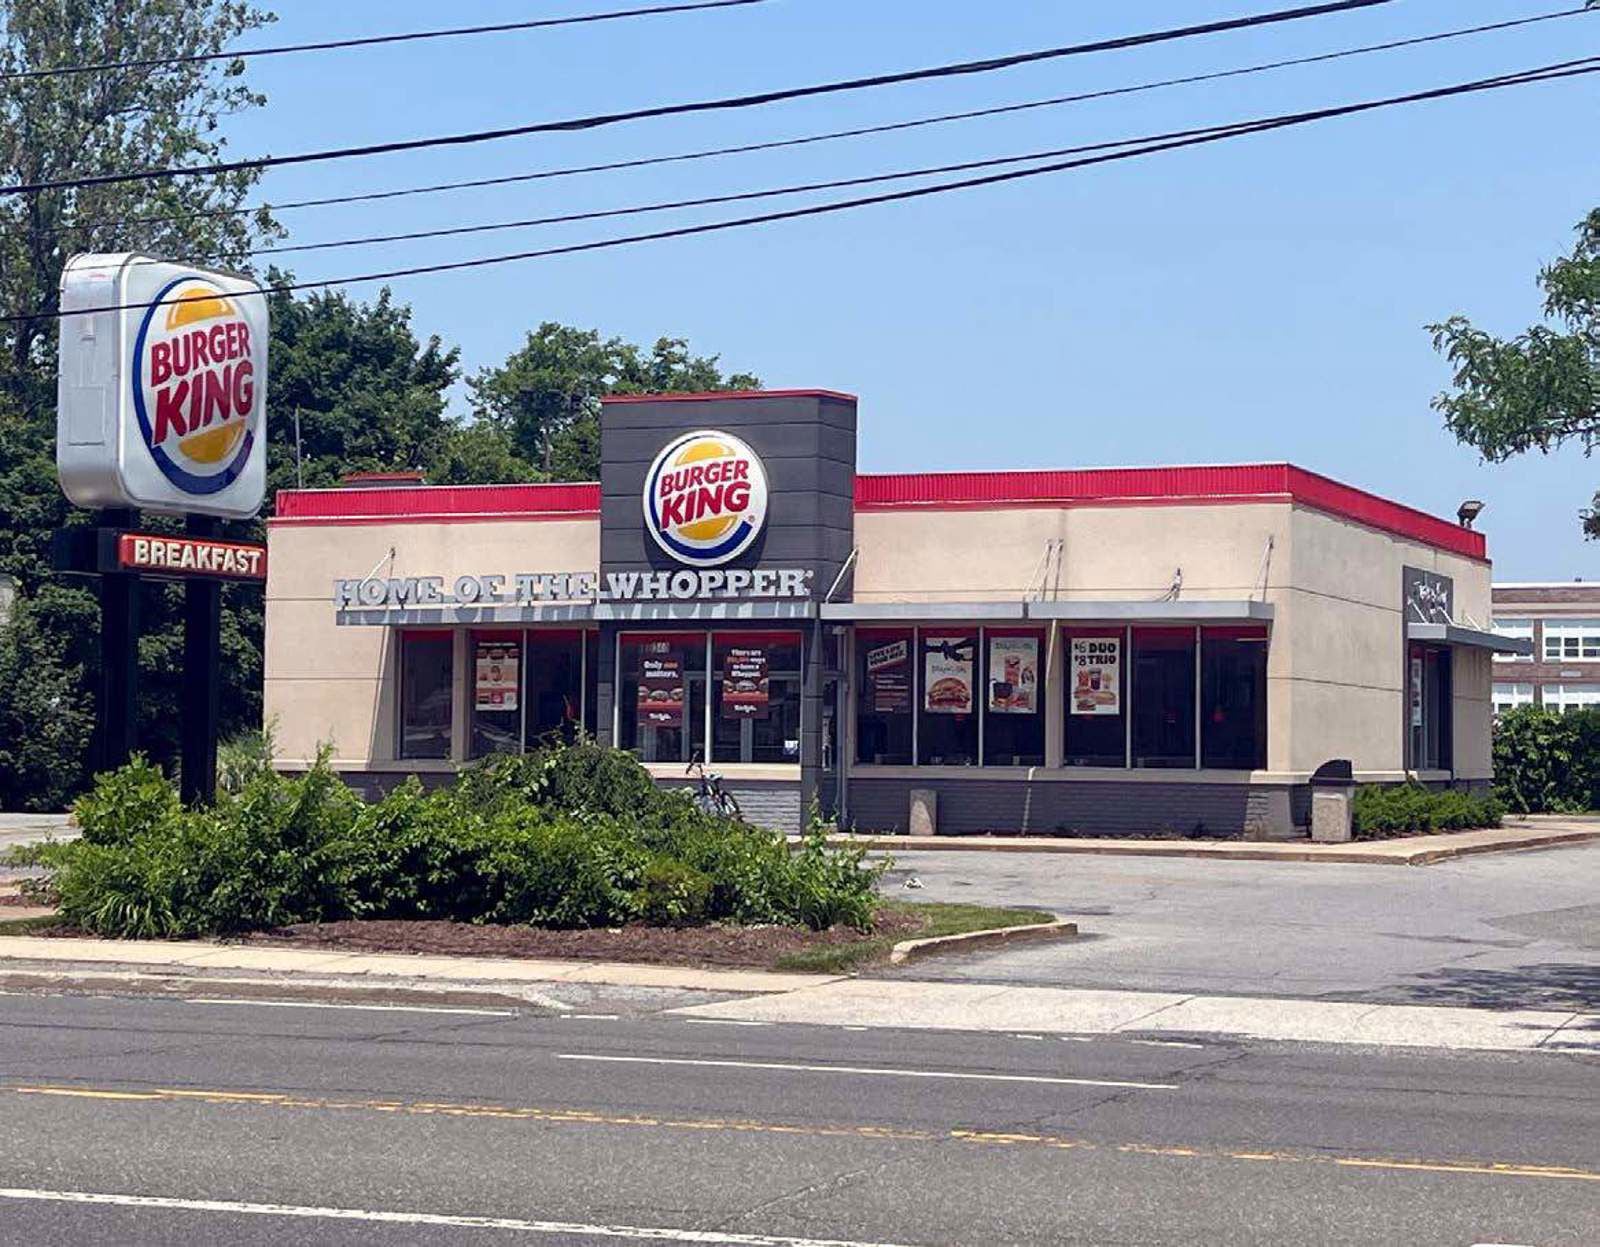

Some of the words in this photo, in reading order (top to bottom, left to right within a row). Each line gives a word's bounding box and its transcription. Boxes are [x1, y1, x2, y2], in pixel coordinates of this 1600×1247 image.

[151, 321, 249, 387] BURGER
[153, 360, 254, 445] KING
[660, 459, 749, 497] BURGER
[661, 481, 752, 529] KING
[134, 539, 261, 574] BREAKFAST
[334, 578, 443, 607] HOME
[454, 575, 505, 603] OF
[516, 572, 596, 603] THE
[606, 569, 810, 599] WHOPPER
[1088, 654, 1116, 665] TRIO
[1089, 642, 1116, 653] DUO
